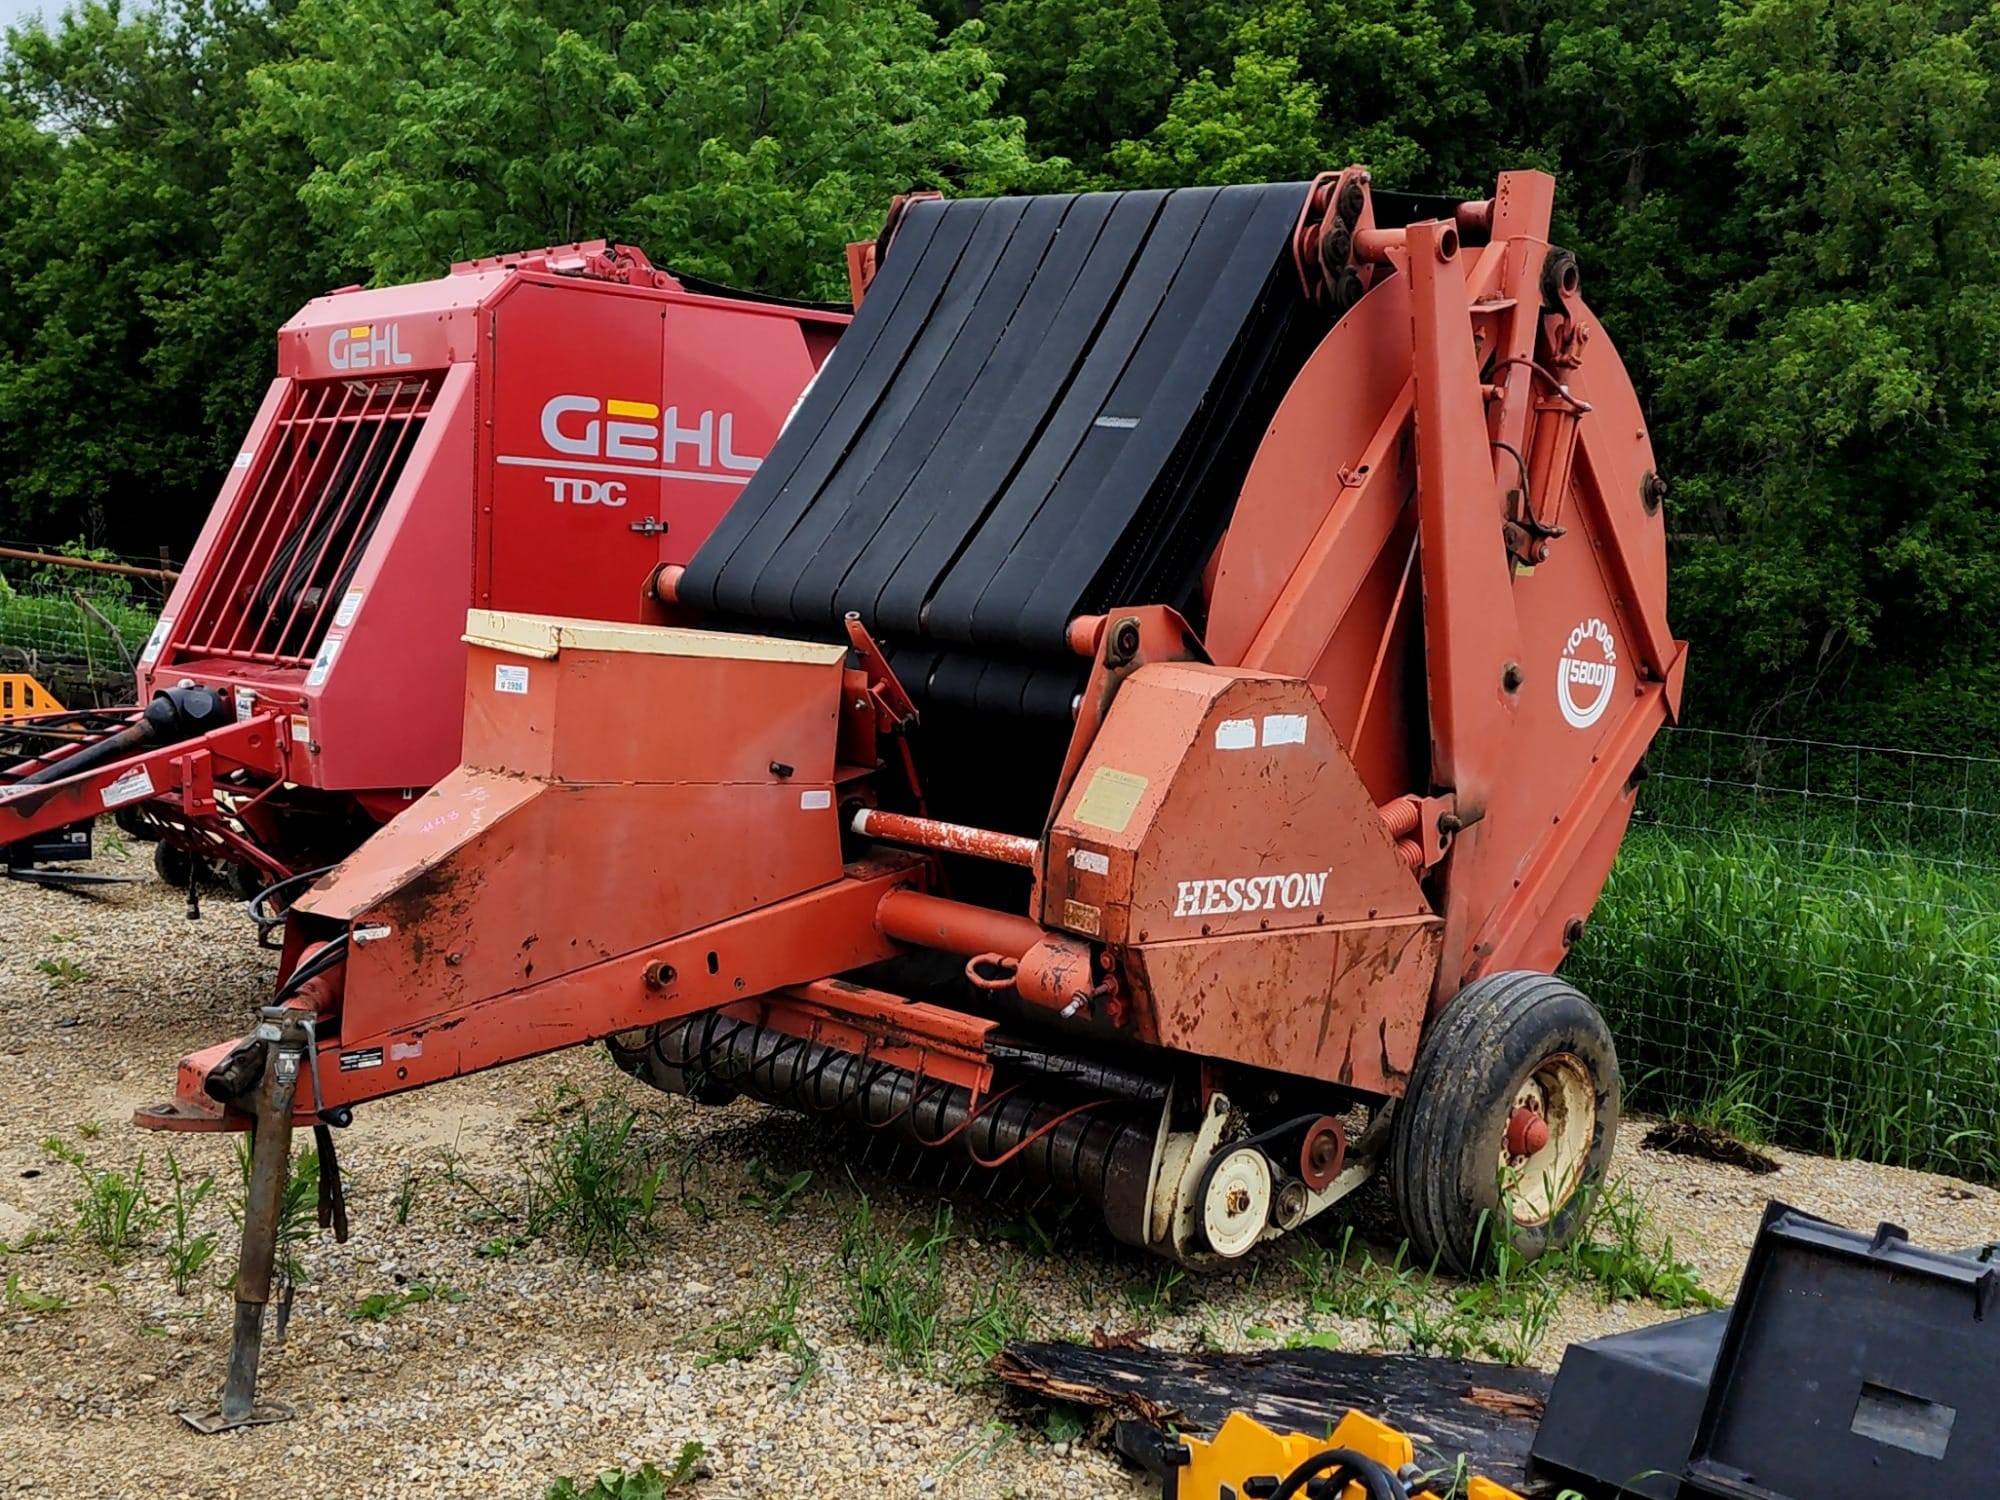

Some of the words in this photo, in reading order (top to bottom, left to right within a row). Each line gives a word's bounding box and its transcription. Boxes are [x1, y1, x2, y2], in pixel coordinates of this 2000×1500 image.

[328, 323, 412, 369] GEHL
[541, 395, 764, 471] GEHL
[545, 477, 627, 507] TDC
[1570, 660, 1604, 686] 5800
[1174, 873, 1328, 917] HESSTON
